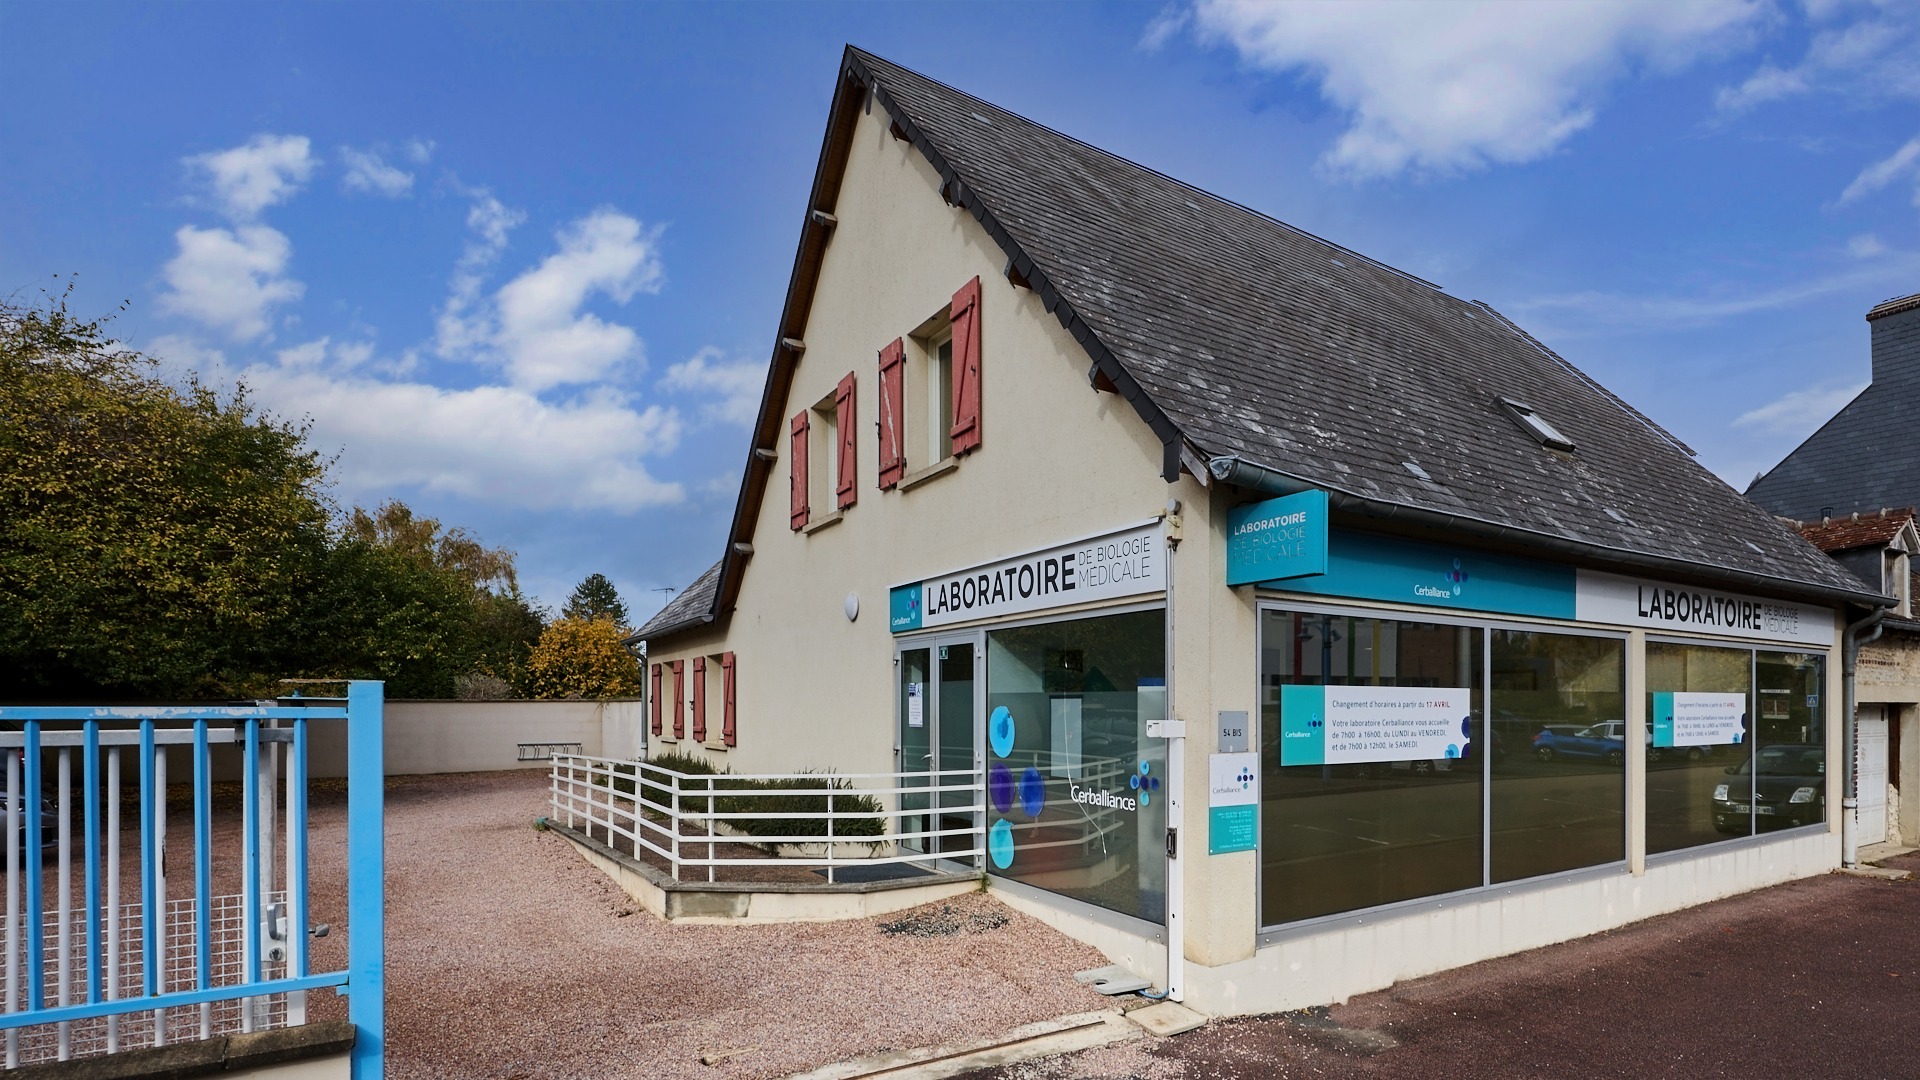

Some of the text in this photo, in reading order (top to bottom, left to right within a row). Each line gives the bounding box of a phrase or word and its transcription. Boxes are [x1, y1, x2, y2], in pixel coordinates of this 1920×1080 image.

[1234, 512, 1306, 535] LABORATOIRE
[1234, 526, 1305, 550] DE BIOLOGIE
[928, 536, 1150, 616] LABORATOIRE DE BIOLOGIE
[1414, 584, 1450, 598] Cerballiance
[1638, 585, 1798, 630] LABORATOIRE DE BIOLOGIE
[1332, 700, 1368, 709] Changement
[1402, 701, 1416, 709] partir
[1341, 731, 1355, 739] 7h00
[1384, 730, 1390, 738] du
[1349, 719, 1380, 727] laboratoire
[1071, 785, 1136, 811] Cerballiance
